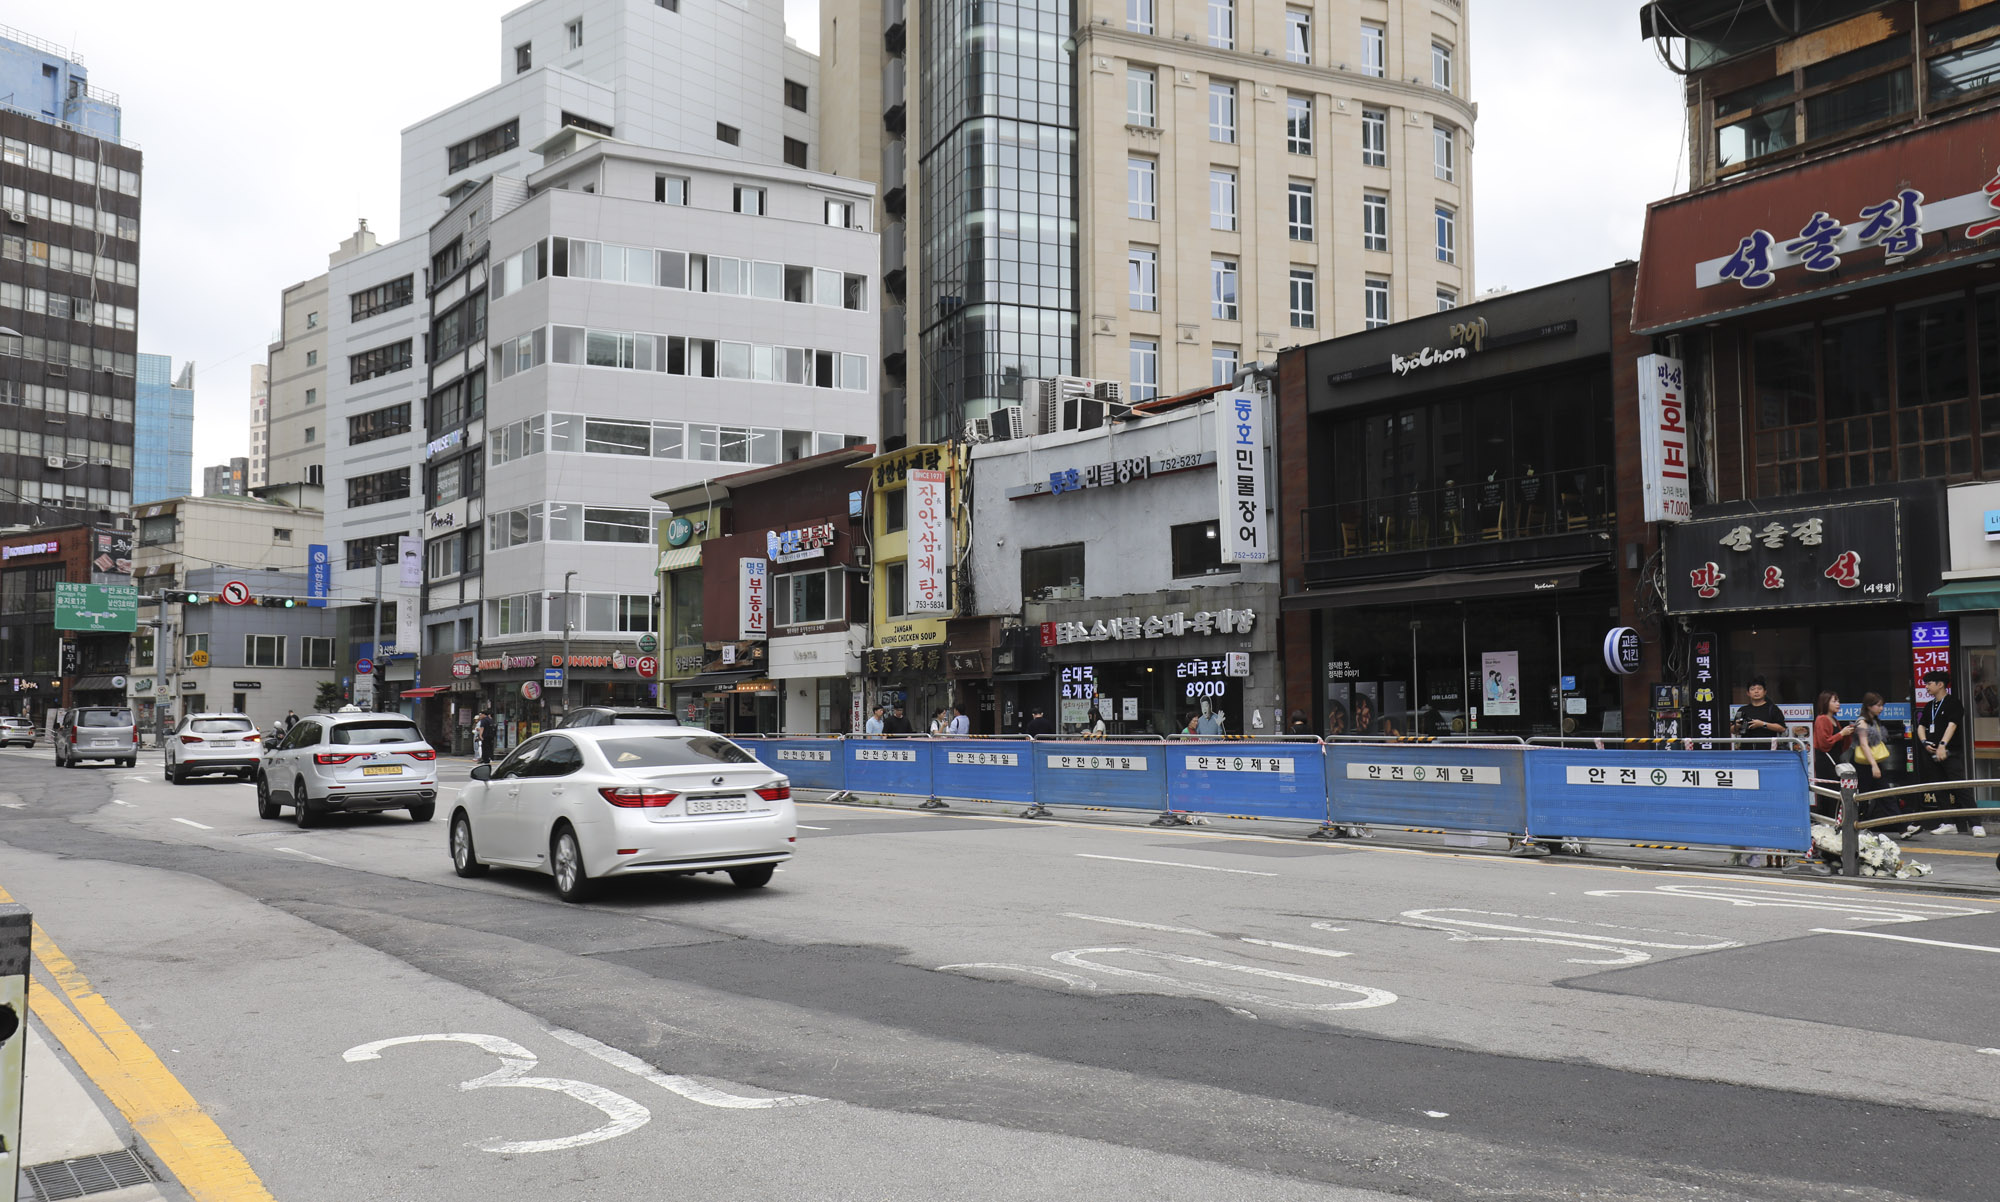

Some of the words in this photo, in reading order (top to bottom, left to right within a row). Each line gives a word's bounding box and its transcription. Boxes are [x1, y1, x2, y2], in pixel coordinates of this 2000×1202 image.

[1719, 188, 1924, 289] 선술집
[1391, 347, 1467, 376] KyoChon
[1658, 362, 1682, 391] 만선
[1234, 399, 1254, 445] 동호
[1660, 393, 1688, 480] 호프
[1034, 483, 1043, 493] 2F
[1050, 467, 1081, 496] 동호
[1085, 455, 1151, 488] 민물장어
[1160, 453, 1203, 471] 752-5237
[1236, 449, 1258, 548] 민물장어
[1991, 516, 2000, 524] Li
[668, 520, 689, 540] Olive
[1719, 518, 1824, 551] 선술집
[917, 484, 939, 600] 장안삼계탕
[1234, 552, 1266, 560] 752-5237
[746, 562, 765, 575] 명문
[1690, 561, 1726, 598] 만
[1763, 565, 1785, 589] &
[1824, 551, 1862, 588] 선
[108, 587, 136, 596] 반포대교
[748, 578, 763, 629] 부동산
[916, 600, 944, 609] 753-5834
[898, 632, 919, 642] CHICKEN
[920, 631, 937, 641] SOUP
[1621, 635, 1638, 648] 교촌
[1912, 627, 1950, 643] 호프
[1622, 648, 1639, 661] 치킨
[1913, 651, 1949, 664] 노가리
[641, 659, 656, 675] 약
[675, 656, 704, 671] 정원약국
[1176, 661, 1208, 678] 순대국
[1328, 662, 1343, 670] 정직한
[1062, 666, 1094, 682] 순대국
[1328, 670, 1343, 678] 정직한
[1344, 669, 1360, 677] 이야기
[1062, 684, 1094, 700] 육개장
[1185, 680, 1226, 698] 8900
[784, 750, 797, 760] 안전
[809, 751, 824, 760] 제일
[863, 750, 878, 760] 안전
[892, 751, 908, 760] 제일
[956, 753, 975, 763] 안전
[990, 754, 1009, 764] 제일
[1061, 757, 1085, 768] 안전
[1106, 758, 1130, 769] 제일
[1198, 757, 1226, 770] 안전
[1250, 758, 1280, 771] 제일
[1368, 765, 1404, 779] 안전
[1436, 767, 1474, 781] 제일
[1588, 768, 1637, 784] 안전
[1682, 770, 1733, 787] 제일
